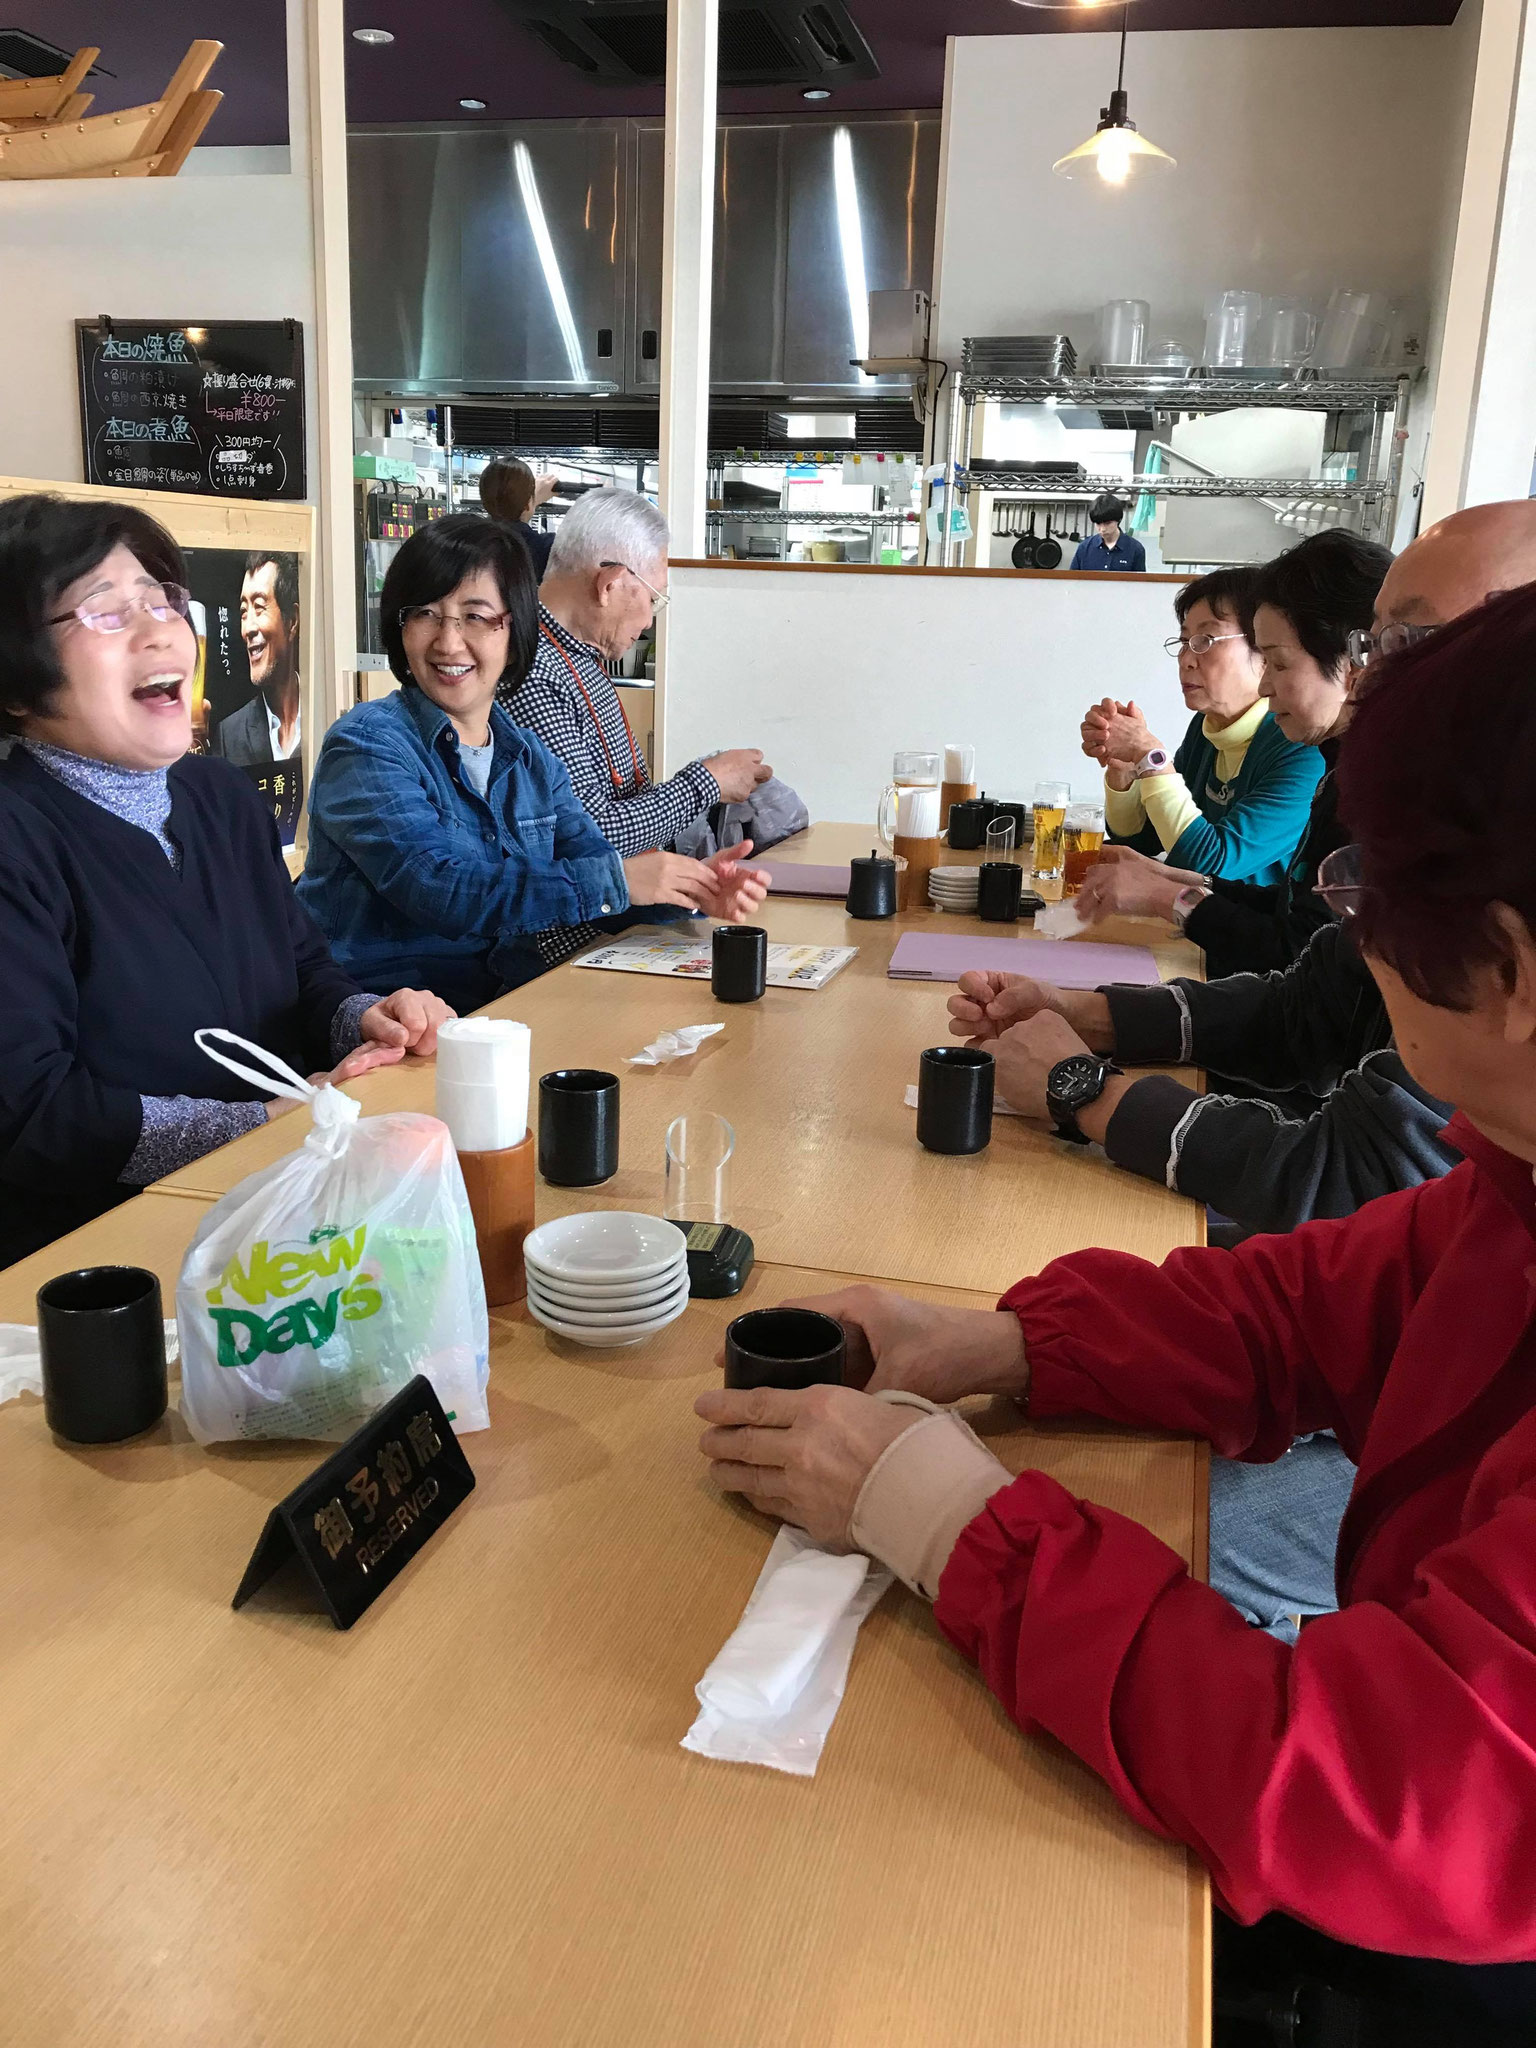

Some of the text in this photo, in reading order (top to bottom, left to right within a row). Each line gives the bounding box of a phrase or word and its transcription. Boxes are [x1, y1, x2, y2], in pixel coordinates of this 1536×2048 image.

[106, 414, 191, 441] 本日の煮魚
[218, 605, 232, 677] 惚れたっ。
[206, 1224, 368, 1305] New
[207, 1273, 383, 1368] Days
[313, 1410, 442, 1561] 御予約席
[355, 1476, 440, 1575] RESERVED
